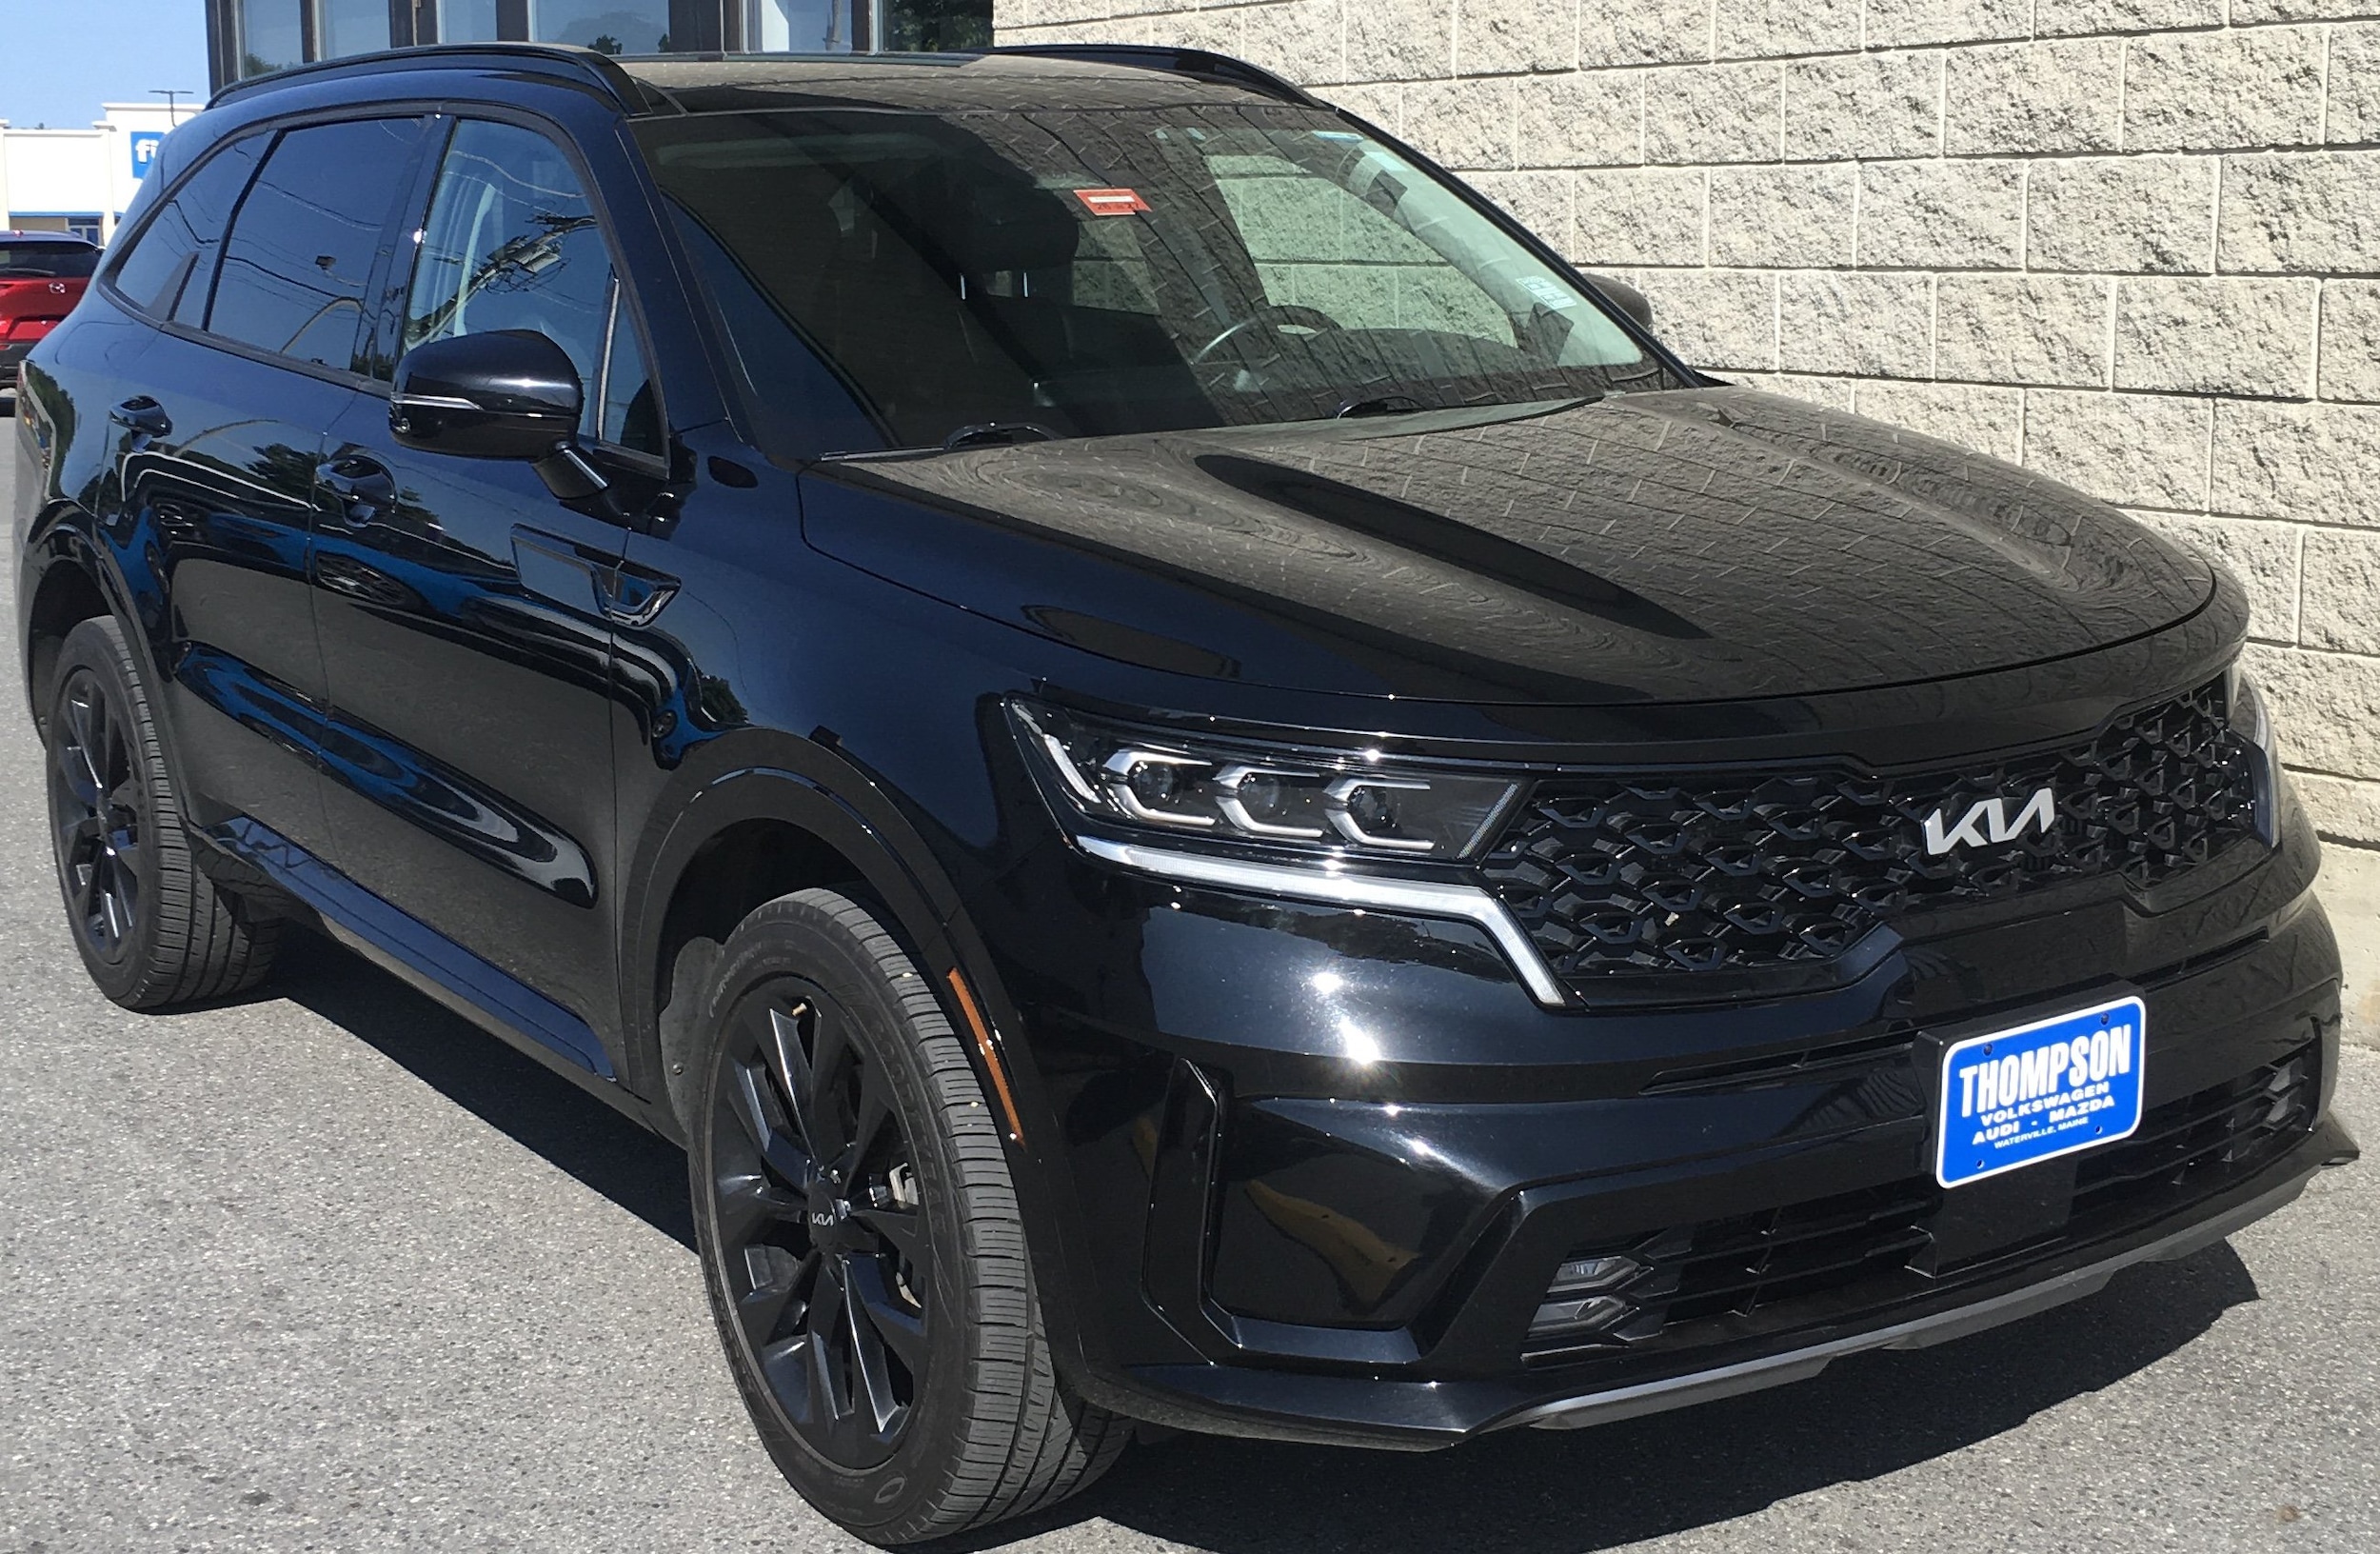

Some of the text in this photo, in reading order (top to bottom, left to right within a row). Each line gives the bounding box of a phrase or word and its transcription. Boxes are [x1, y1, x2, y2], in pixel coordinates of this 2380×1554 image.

[1924, 787, 2054, 855] KIA
[1959, 1024, 2132, 1118] THOMPSON
[1972, 1121, 2019, 1145] AUDI
[2049, 1095, 2115, 1124] MAZDA
[1980, 1082, 2110, 1126] VOLKSWAGEN
[2057, 1117, 2089, 1131] MAINE
[811, 1212, 834, 1226] KIA
